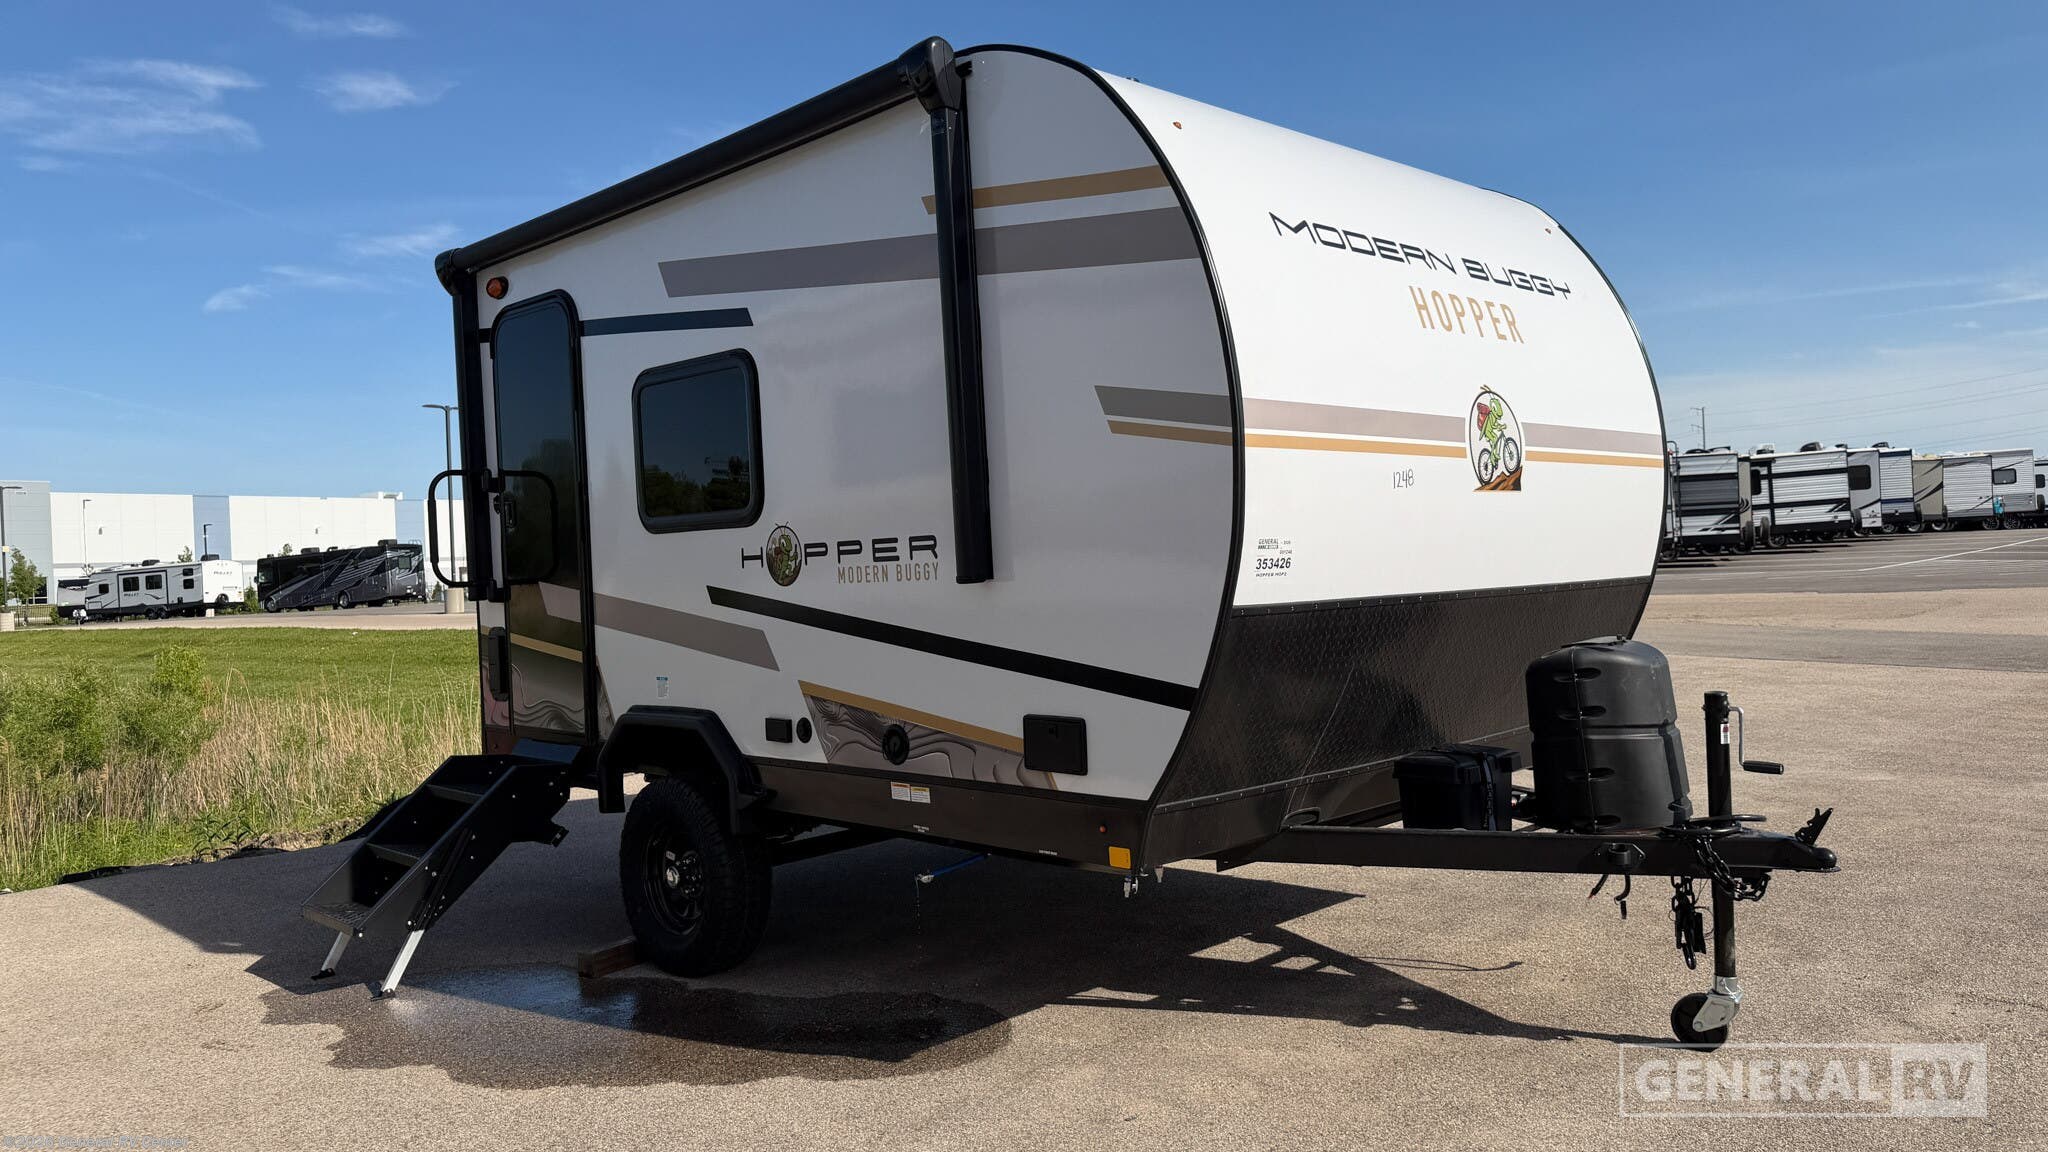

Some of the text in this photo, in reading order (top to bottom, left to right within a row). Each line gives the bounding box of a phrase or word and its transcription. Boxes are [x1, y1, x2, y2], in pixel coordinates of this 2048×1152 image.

[1269, 211, 1571, 300] MODERN BUGGY
[1409, 285, 1524, 344] HOPPER
[1393, 468, 1415, 489] 1248
[837, 562, 939, 585] MODERN BUGGY
[1256, 557, 1291, 570] 353426
